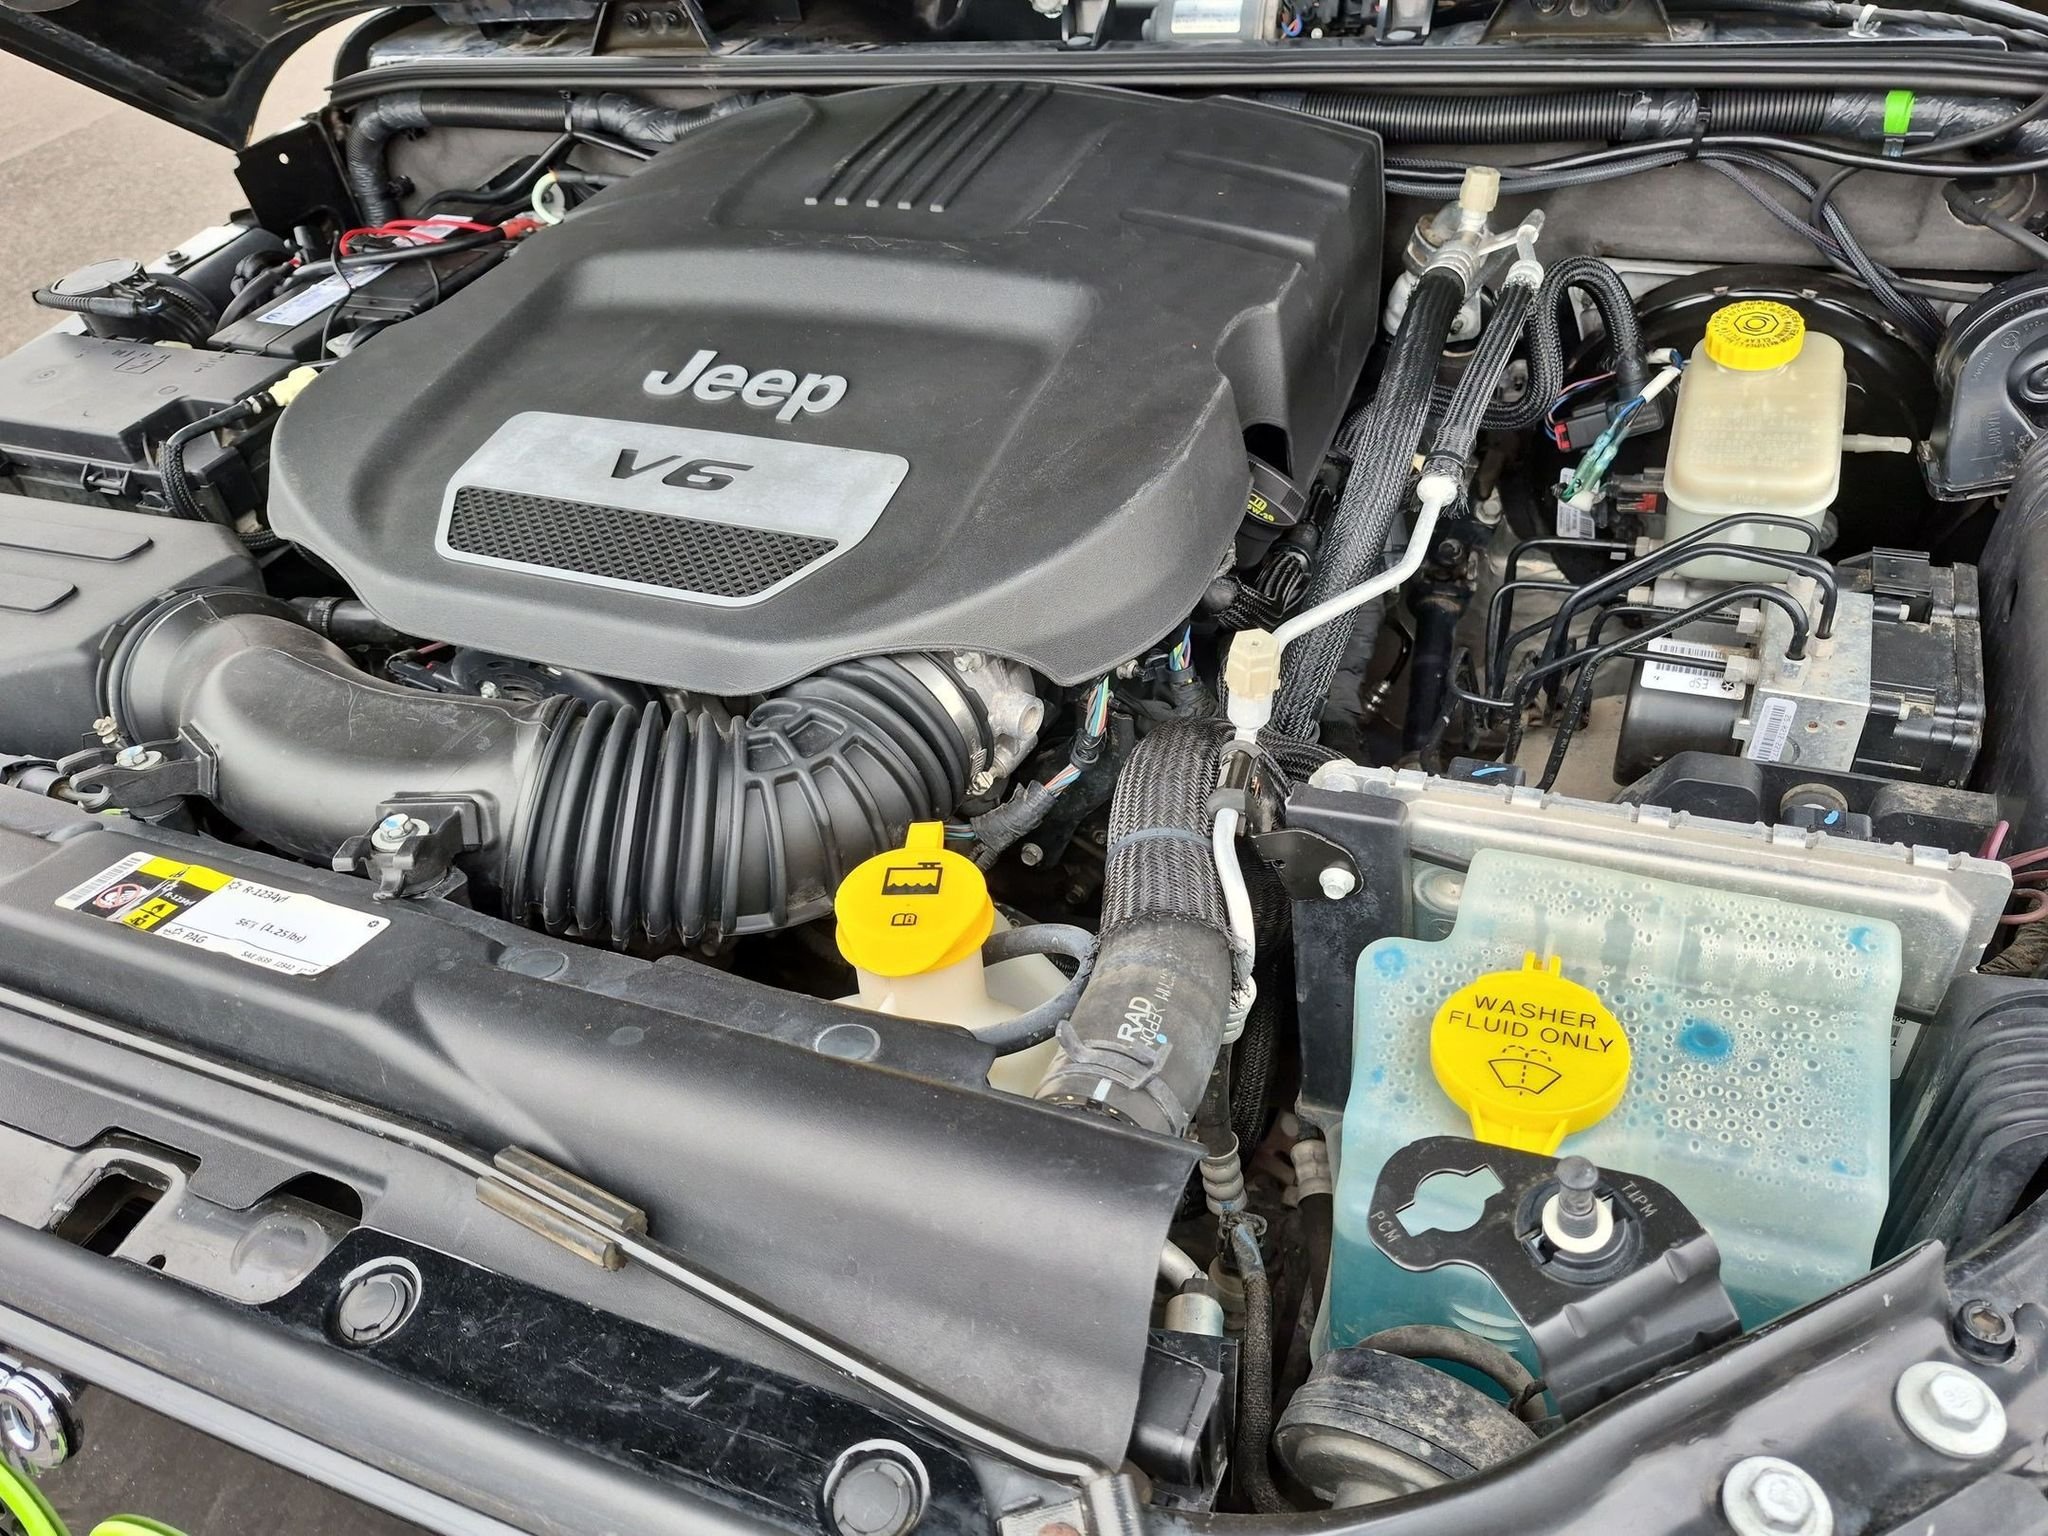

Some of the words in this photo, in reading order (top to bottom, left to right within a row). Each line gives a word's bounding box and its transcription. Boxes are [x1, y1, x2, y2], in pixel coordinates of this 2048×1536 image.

[643, 349, 848, 424] Jeep
[611, 448, 754, 491] V6
[1688, 677, 1709, 690] ESP
[183, 932, 208, 944] PAG
[1117, 996, 1152, 1042] RAD
[1449, 1009, 1529, 1038] FLUID
[1540, 1027, 1614, 1053] ONLY
[1475, 994, 1597, 1030] WASHER
[1370, 1209, 1402, 1244] PCM
